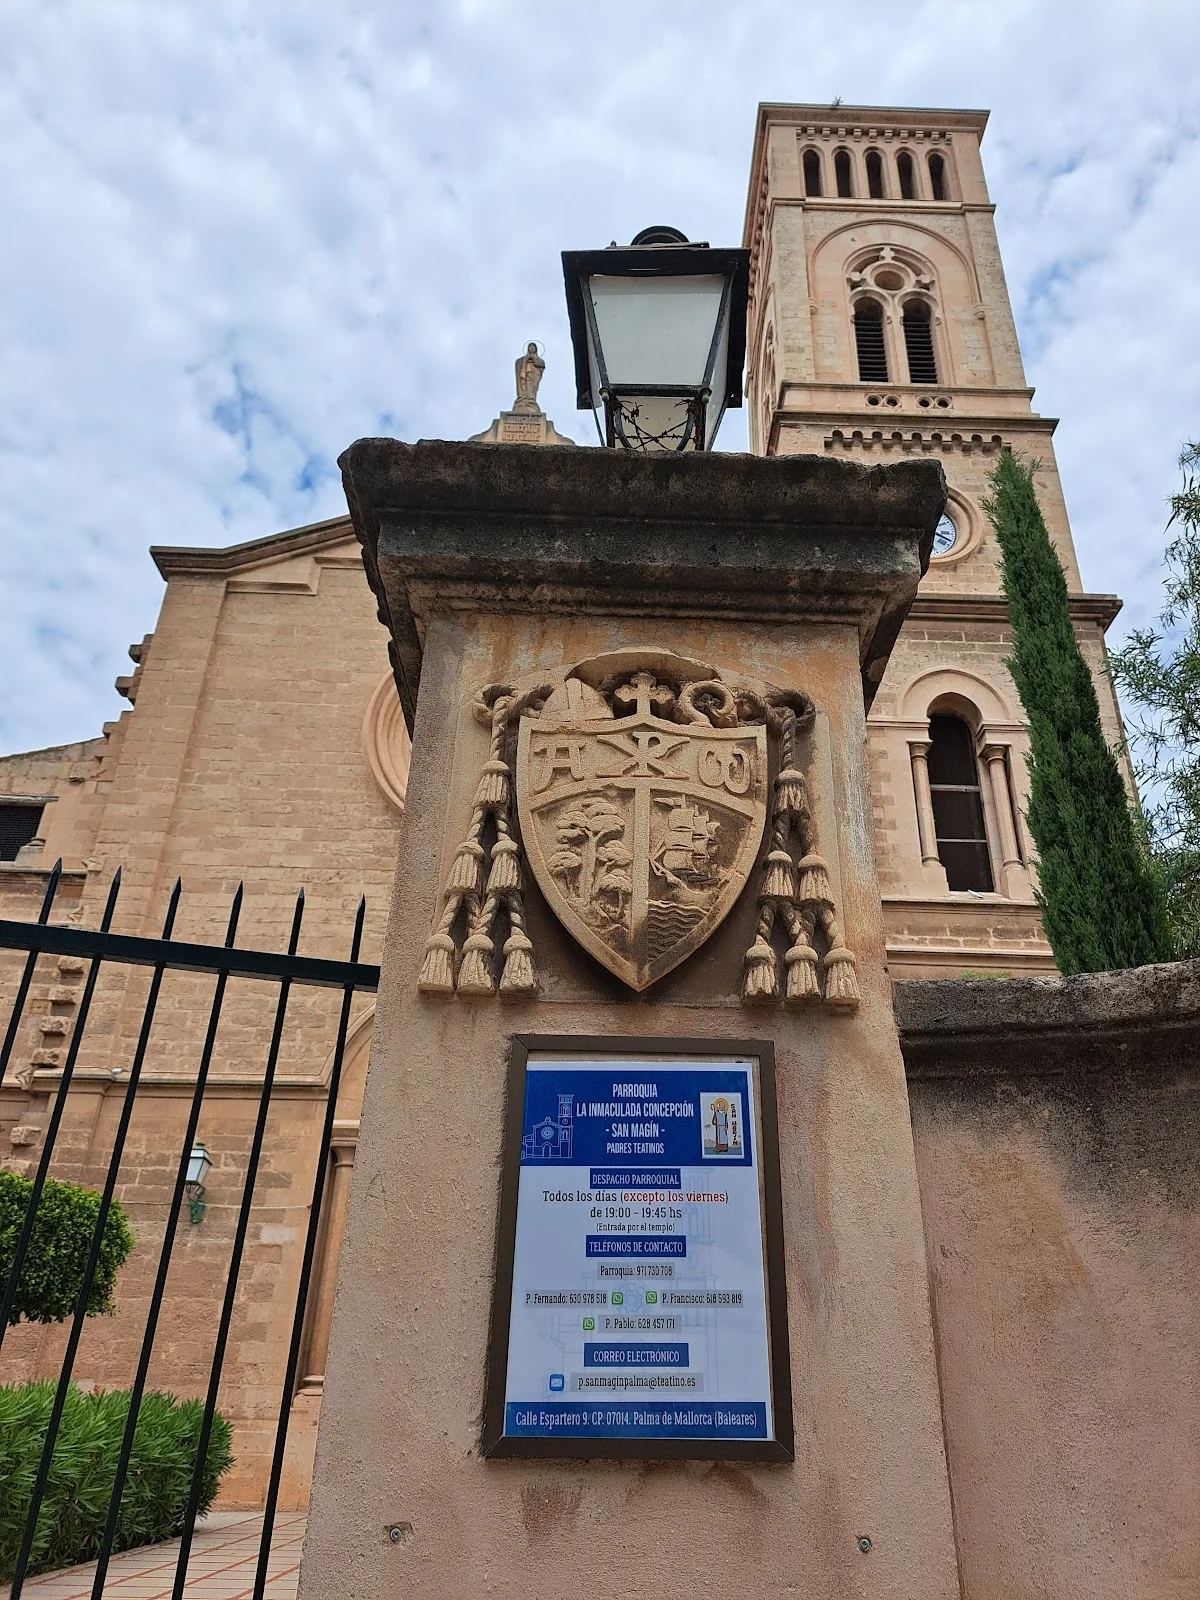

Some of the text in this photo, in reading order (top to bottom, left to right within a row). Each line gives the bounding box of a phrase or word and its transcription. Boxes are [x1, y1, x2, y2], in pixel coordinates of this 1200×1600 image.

[612, 1083, 658, 1099] PARROQUIA
[576, 1100, 695, 1117] LA INMACULADA CONCEPCIÓN
[611, 1122, 629, 1138] SAN
[630, 1120, 659, 1138] MAGÍN
[606, 1142, 665, 1154] PADRES TEATINOS
[592, 1174, 680, 1186] DESPACHO PARROQUIAL
[543, 1190, 729, 1204] Todos los días (excepto los viernes)
[590, 1207, 603, 1218] de
[605, 1207, 631, 1218] 19:00
[641, 1207, 667, 1218] 19:45
[669, 1207, 682, 1218] hs
[596, 1222, 676, 1234] (Entrada por el templo)
[589, 1238, 683, 1253] TELÉFONOS DE CONTACTO
[600, 1265, 635, 1279] Parroquia:
[526, 1293, 533, 1304] P.
[534, 1293, 568, 1304] Fernando:
[582, 1293, 595, 1304] 978
[662, 1293, 669, 1304] P.
[670, 1292, 705, 1304] Francisco:
[605, 1318, 612, 1329] P.
[613, 1317, 636, 1329] Pablo:
[652, 1318, 665, 1329] 457
[666, 1318, 675, 1329] 171
[593, 1348, 680, 1363] CORREO ELECTRÓNICO
[578, 1375, 696, 1390] p.sanmaginpalma@teatino.es
[516, 1411, 537, 1426] Calle
[539, 1411, 581, 1430] Espartero
[591, 1411, 605, 1426] CP.
[606, 1411, 632, 1426] 07014.
[633, 1411, 660, 1426] Palma
[661, 1411, 672, 1426] de
[673, 1411, 713, 1426] Mallorca
[714, 1411, 757, 1428] (Baleares)
